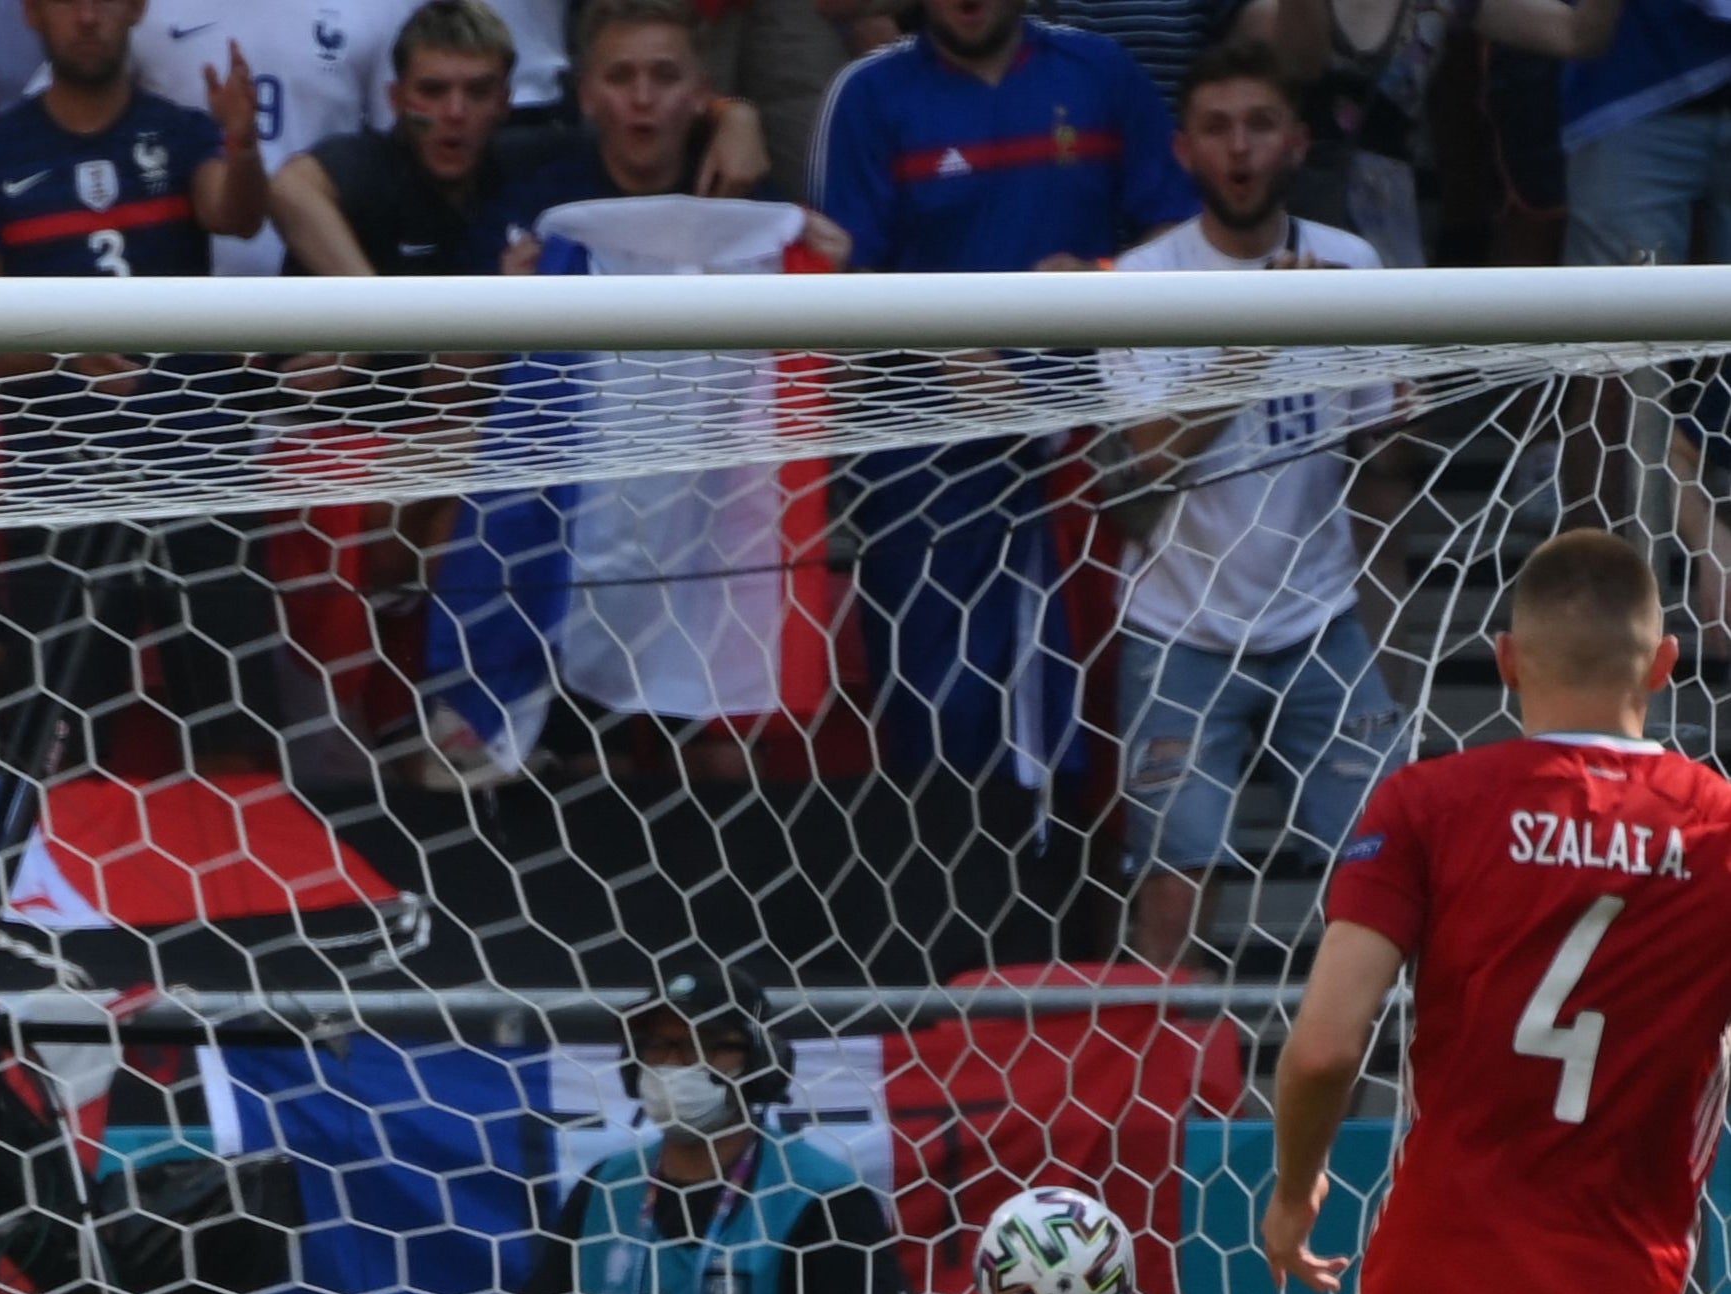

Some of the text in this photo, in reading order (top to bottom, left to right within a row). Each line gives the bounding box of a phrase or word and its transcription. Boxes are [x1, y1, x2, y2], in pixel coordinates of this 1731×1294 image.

[1509, 809, 1693, 881] SZALAI A.
[1513, 894, 1627, 1125] 4
